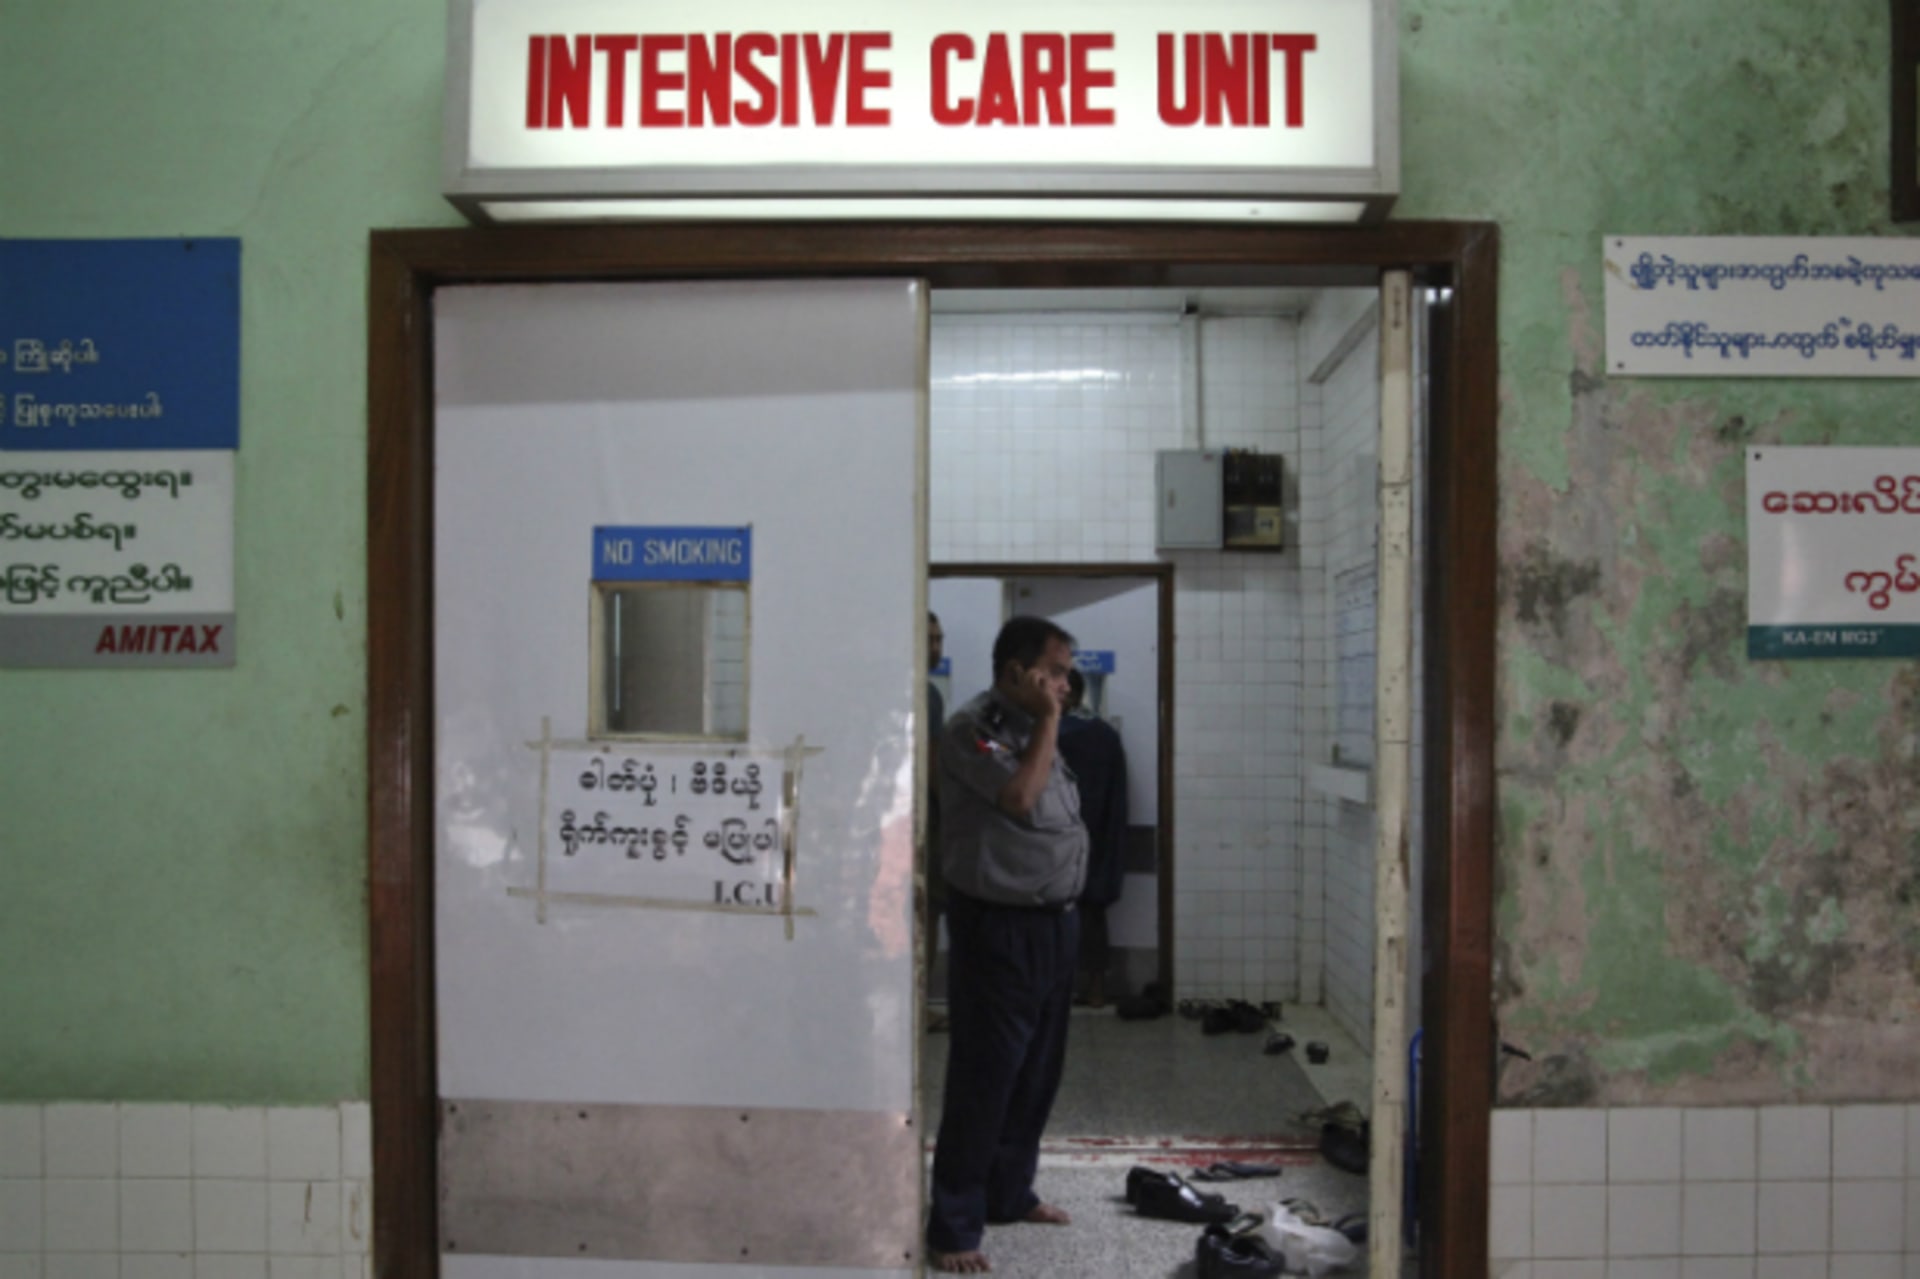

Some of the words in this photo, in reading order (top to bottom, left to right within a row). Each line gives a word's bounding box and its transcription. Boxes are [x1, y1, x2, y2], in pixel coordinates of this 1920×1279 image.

[525, 31, 892, 129] INTENSIVE
[929, 31, 1115, 128] CARE
[1157, 32, 1317, 128] UNIT
[602, 538, 633, 566] NO
[643, 537, 743, 566] SMOKING
[95, 624, 223, 655] AMITAX
